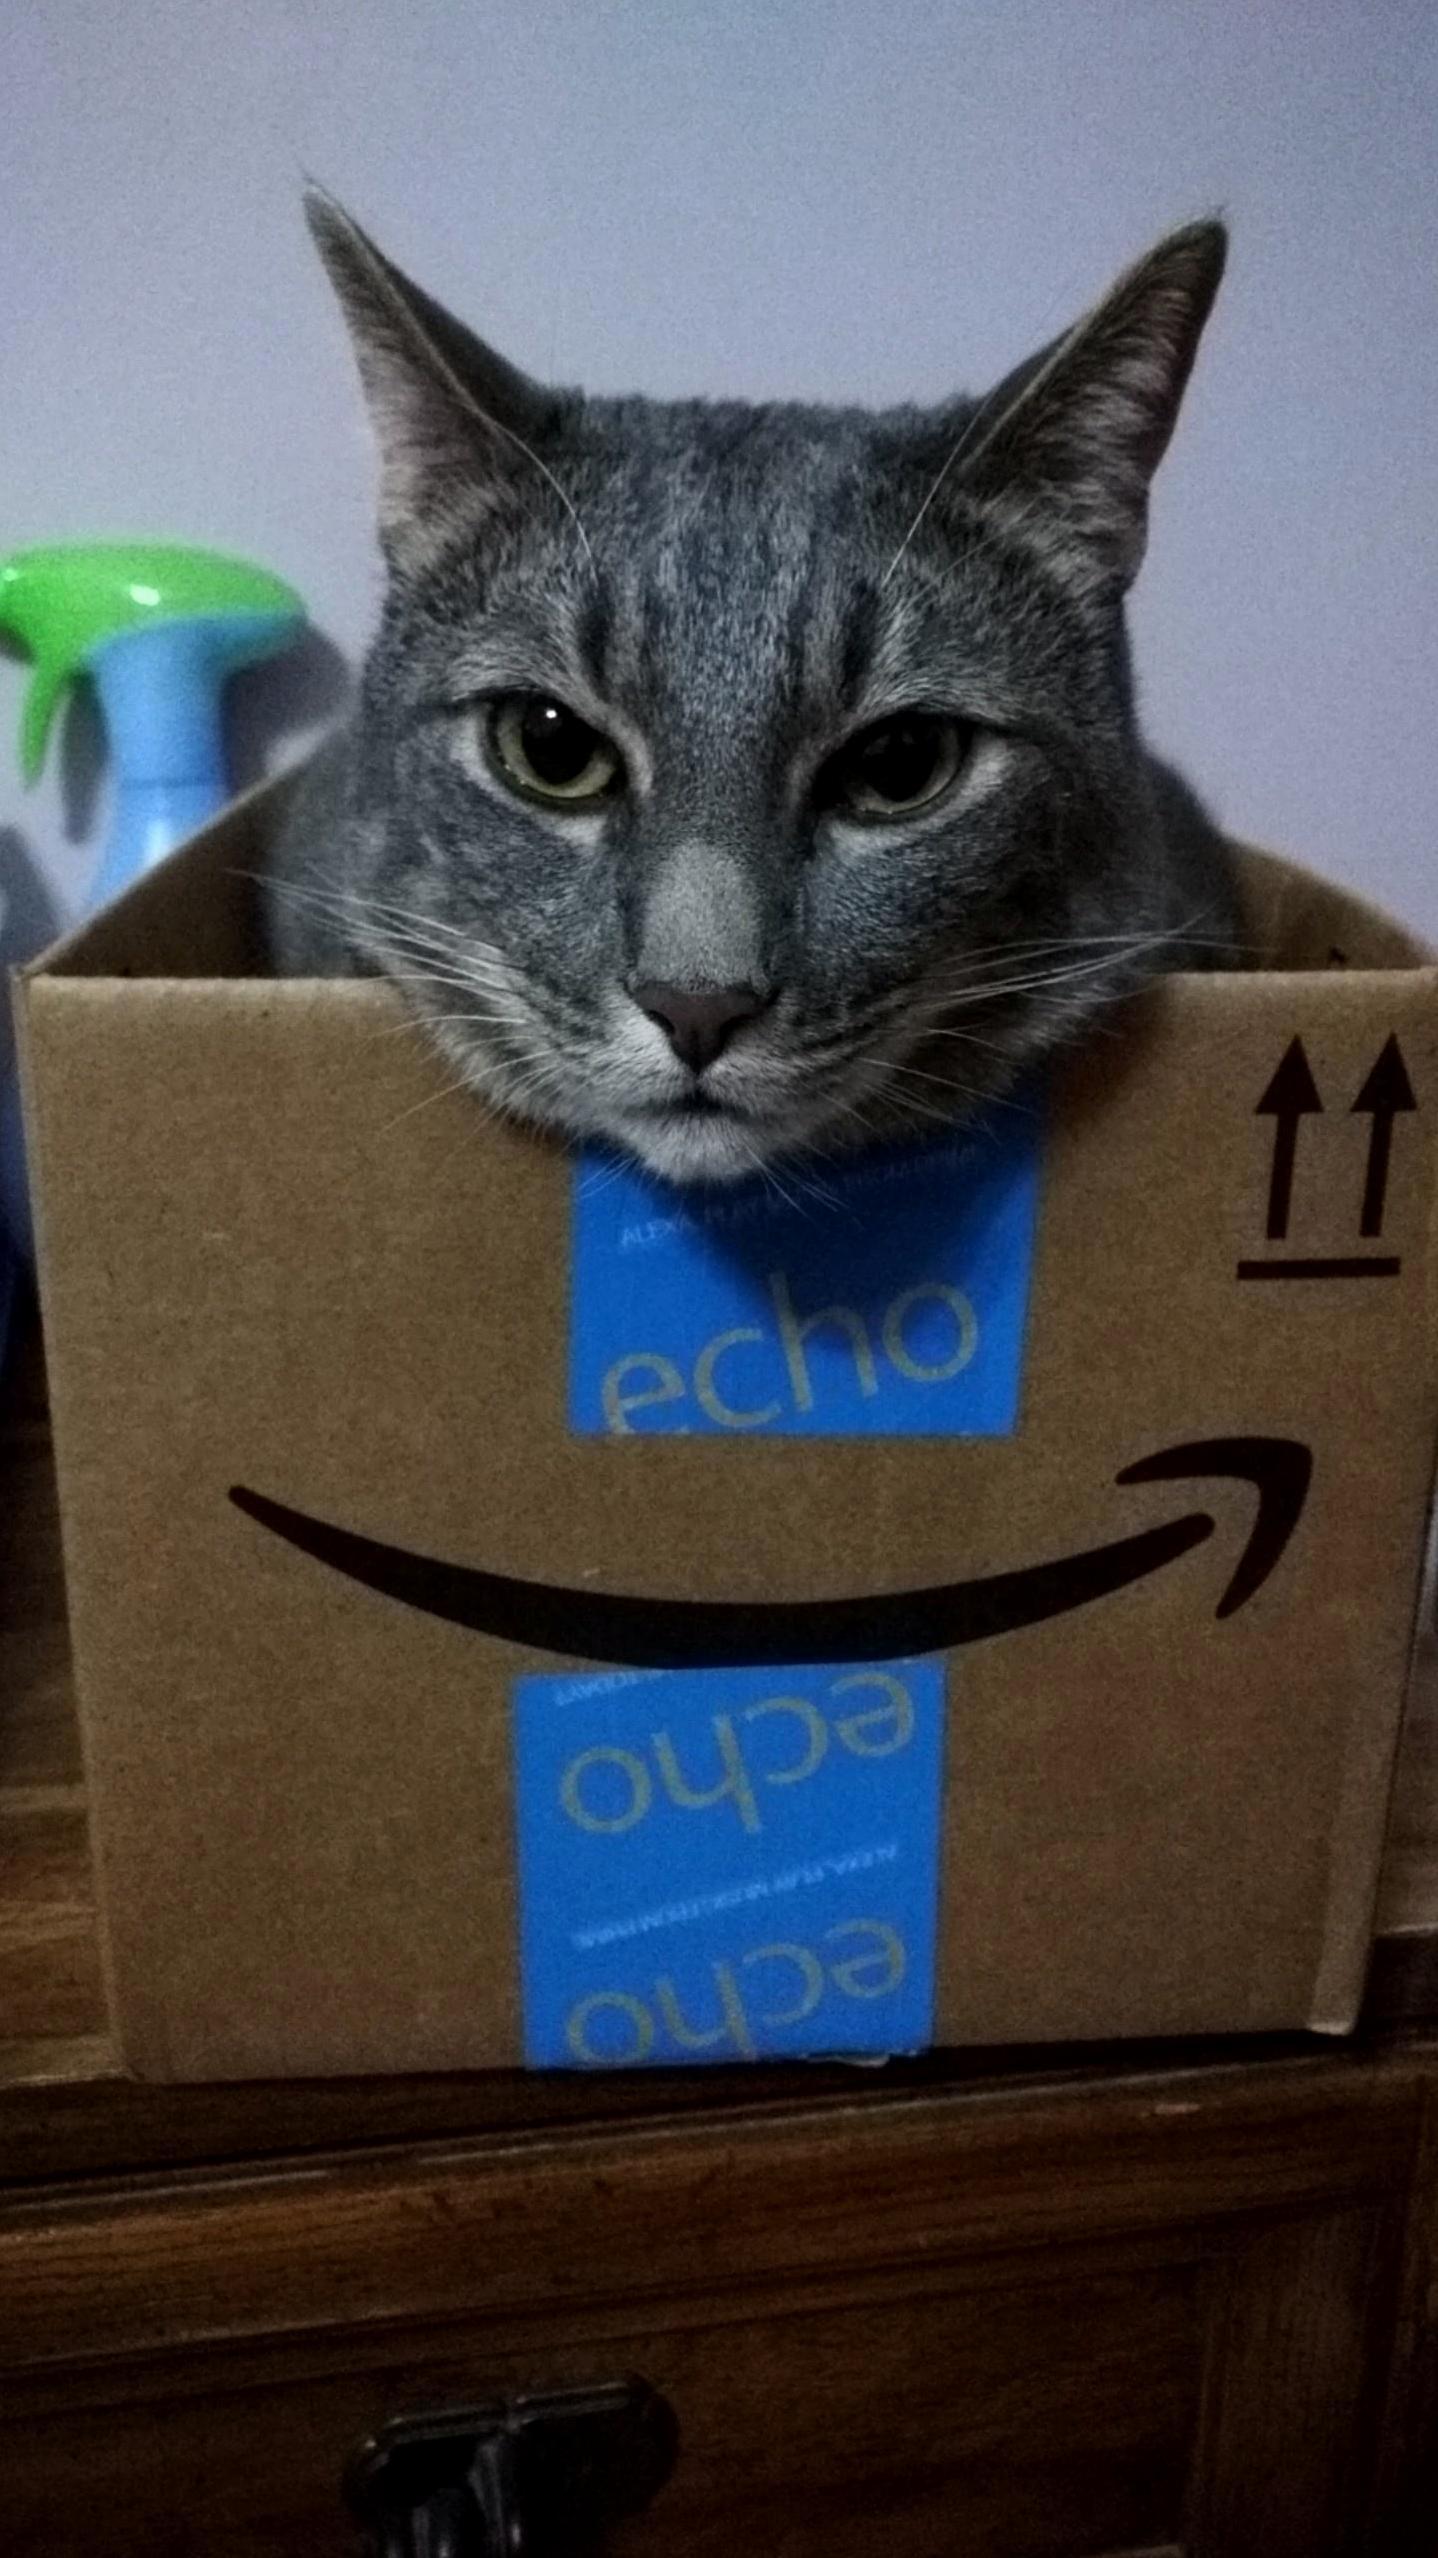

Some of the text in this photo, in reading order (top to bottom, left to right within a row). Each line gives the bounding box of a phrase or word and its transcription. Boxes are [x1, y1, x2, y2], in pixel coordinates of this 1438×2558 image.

[602, 1271, 979, 1434] echo
[560, 1671, 915, 1834] echo
[565, 1918, 906, 2063] echo
